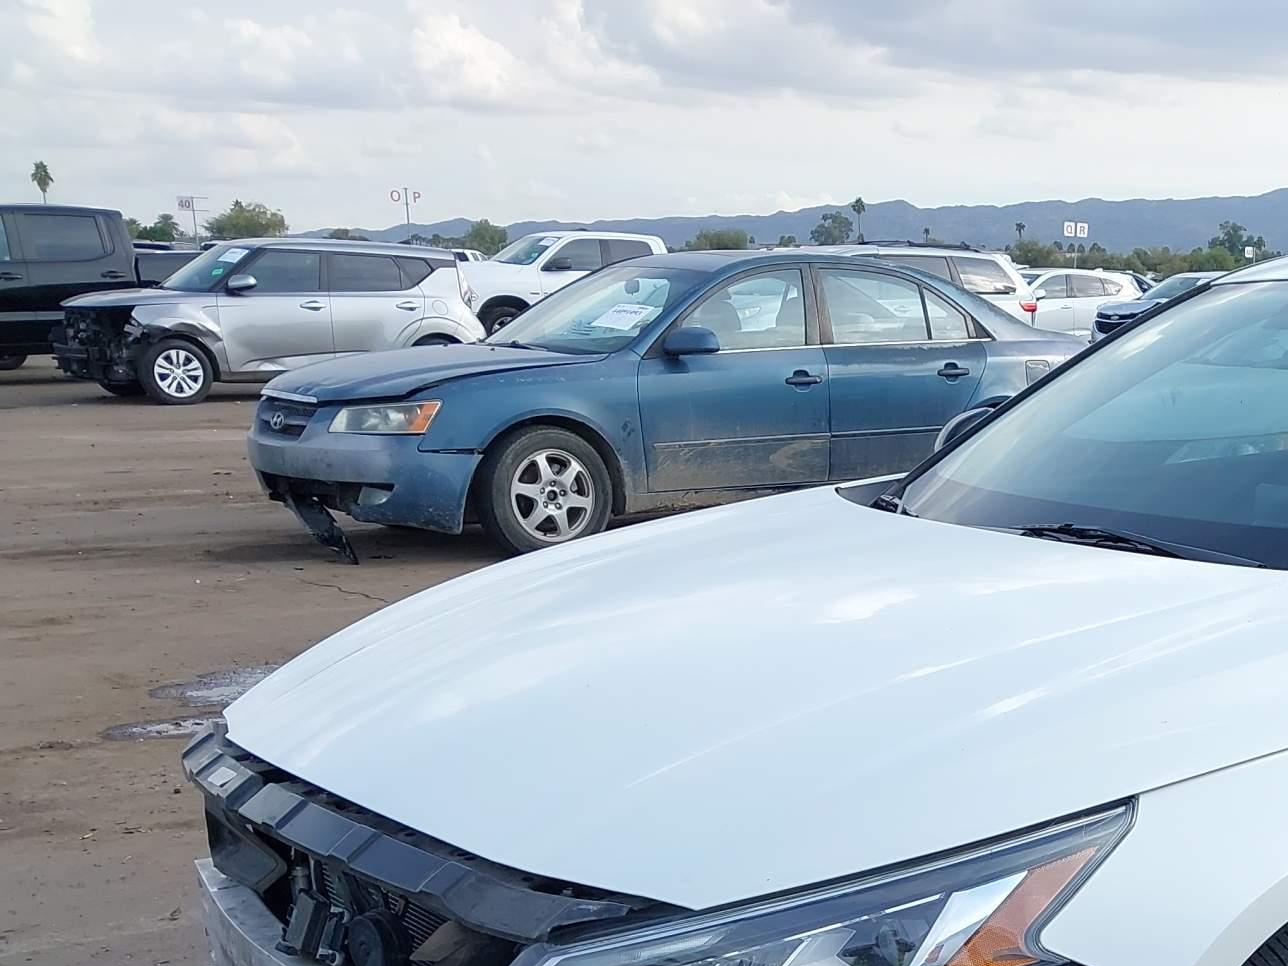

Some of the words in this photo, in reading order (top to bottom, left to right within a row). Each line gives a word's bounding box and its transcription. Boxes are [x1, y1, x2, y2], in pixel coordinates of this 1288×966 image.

[390, 190, 401, 202] O
[413, 191, 421, 203] P
[178, 199, 191, 209] 40
[1066, 225, 1073, 234] Q
[1079, 225, 1086, 235] R
